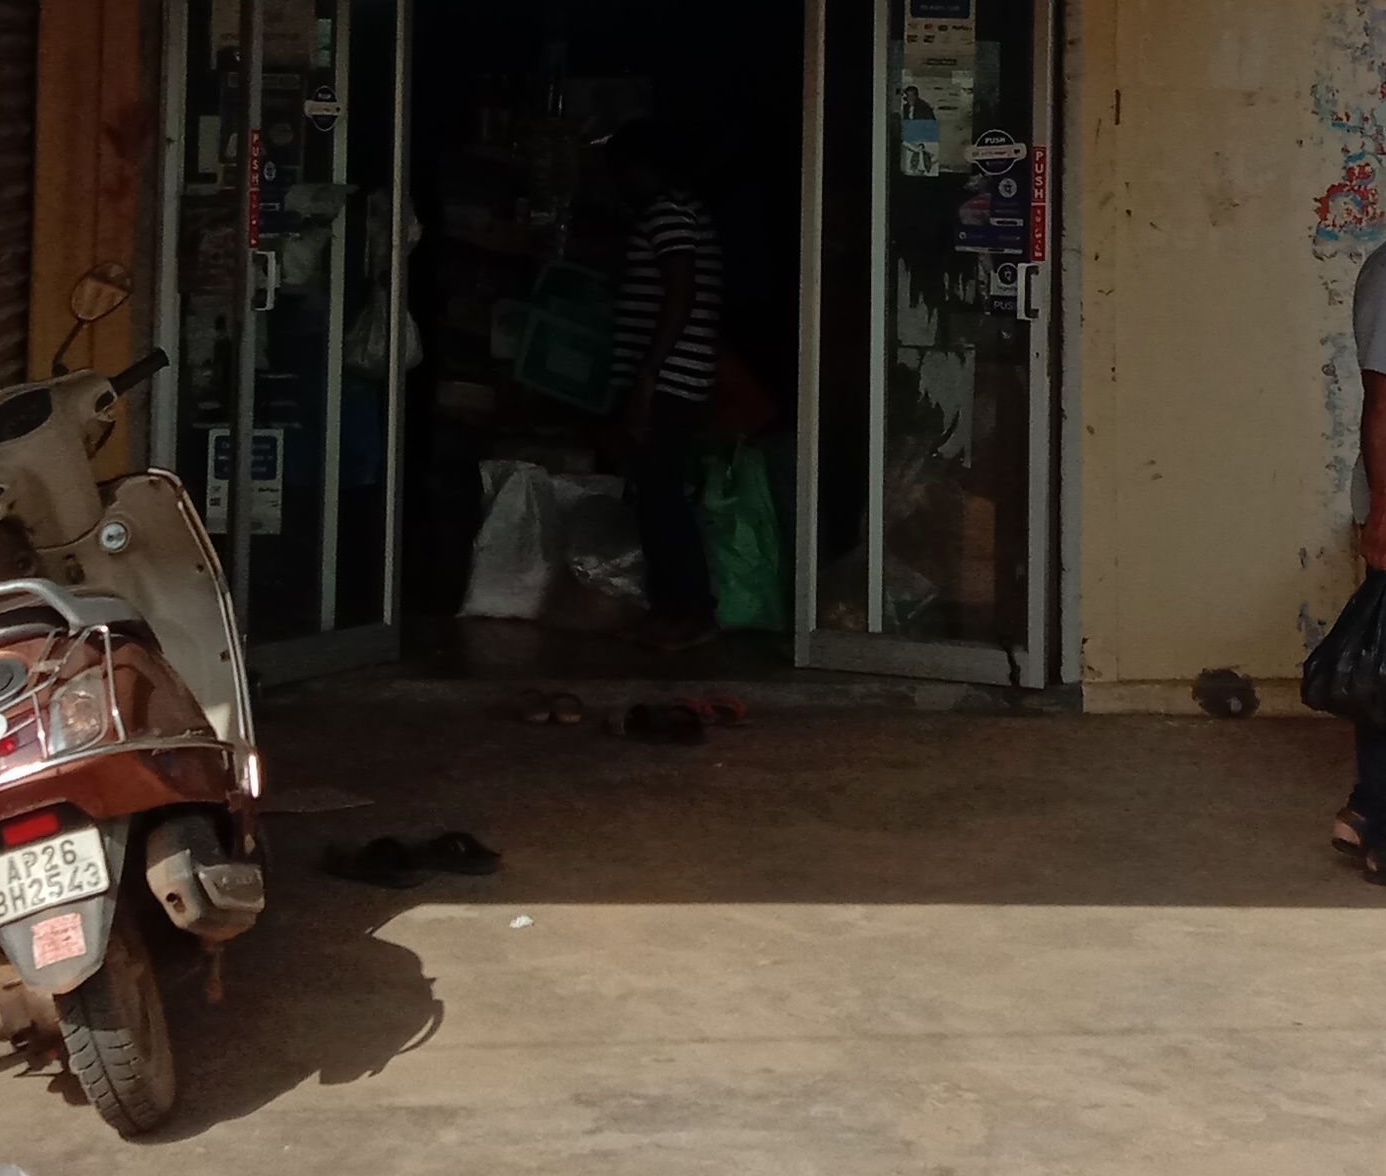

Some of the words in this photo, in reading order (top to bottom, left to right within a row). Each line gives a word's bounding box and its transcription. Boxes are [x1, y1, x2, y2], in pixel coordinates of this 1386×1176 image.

[1034, 150, 1045, 199] PUSH
[994, 300, 1017, 311] PUS
[6, 839, 77, 885] AP26
